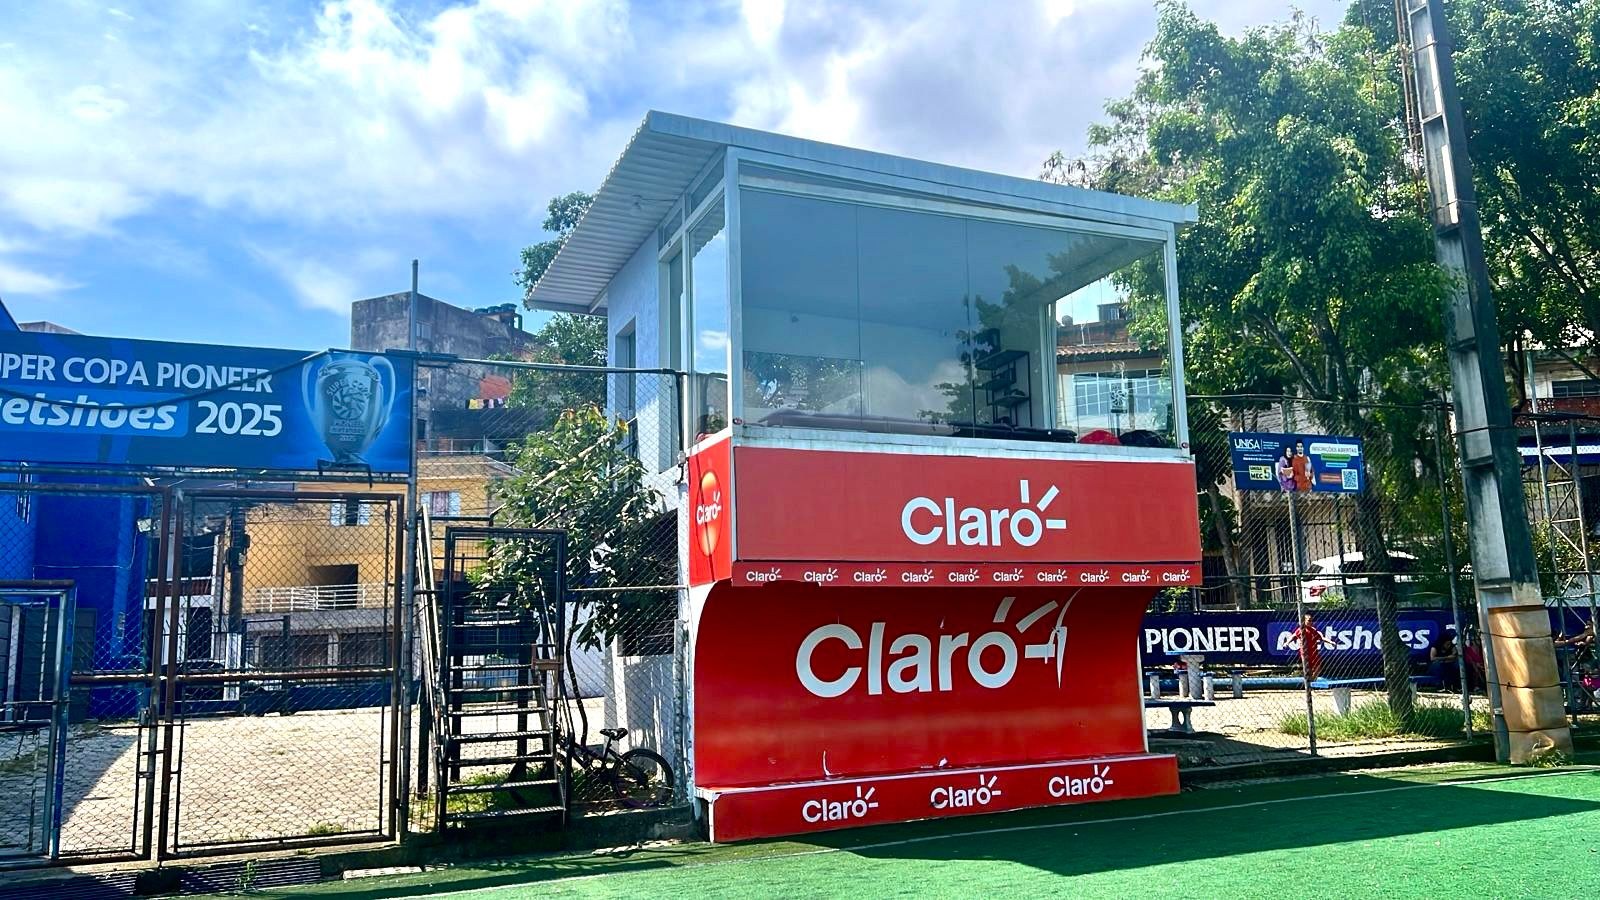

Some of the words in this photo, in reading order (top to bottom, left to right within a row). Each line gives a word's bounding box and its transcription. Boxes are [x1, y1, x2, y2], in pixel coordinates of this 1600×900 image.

[0, 353, 55, 381] PER
[62, 357, 149, 386] COPA
[156, 362, 273, 393] PIONEER
[0, 393, 178, 431] etshoes
[195, 400, 283, 437] 2025
[697, 501, 720, 525] Claro
[901, 496, 1044, 547] Claro
[746, 570, 778, 583] Claro
[803, 570, 835, 583] Claro
[853, 570, 883, 583] Claro
[901, 570, 930, 583] Claro
[948, 570, 976, 583] Claro
[993, 570, 1020, 583] Claro
[1037, 570, 1064, 583] Claro
[1080, 570, 1106, 583] Claro
[1121, 570, 1148, 583] Claro
[1162, 570, 1187, 583] Claro
[795, 620, 1019, 698] Claro
[1144, 626, 1263, 653] PIONEER
[801, 796, 870, 823] Claro
[930, 784, 992, 810] Claro
[1048, 774, 1106, 798] Claro
